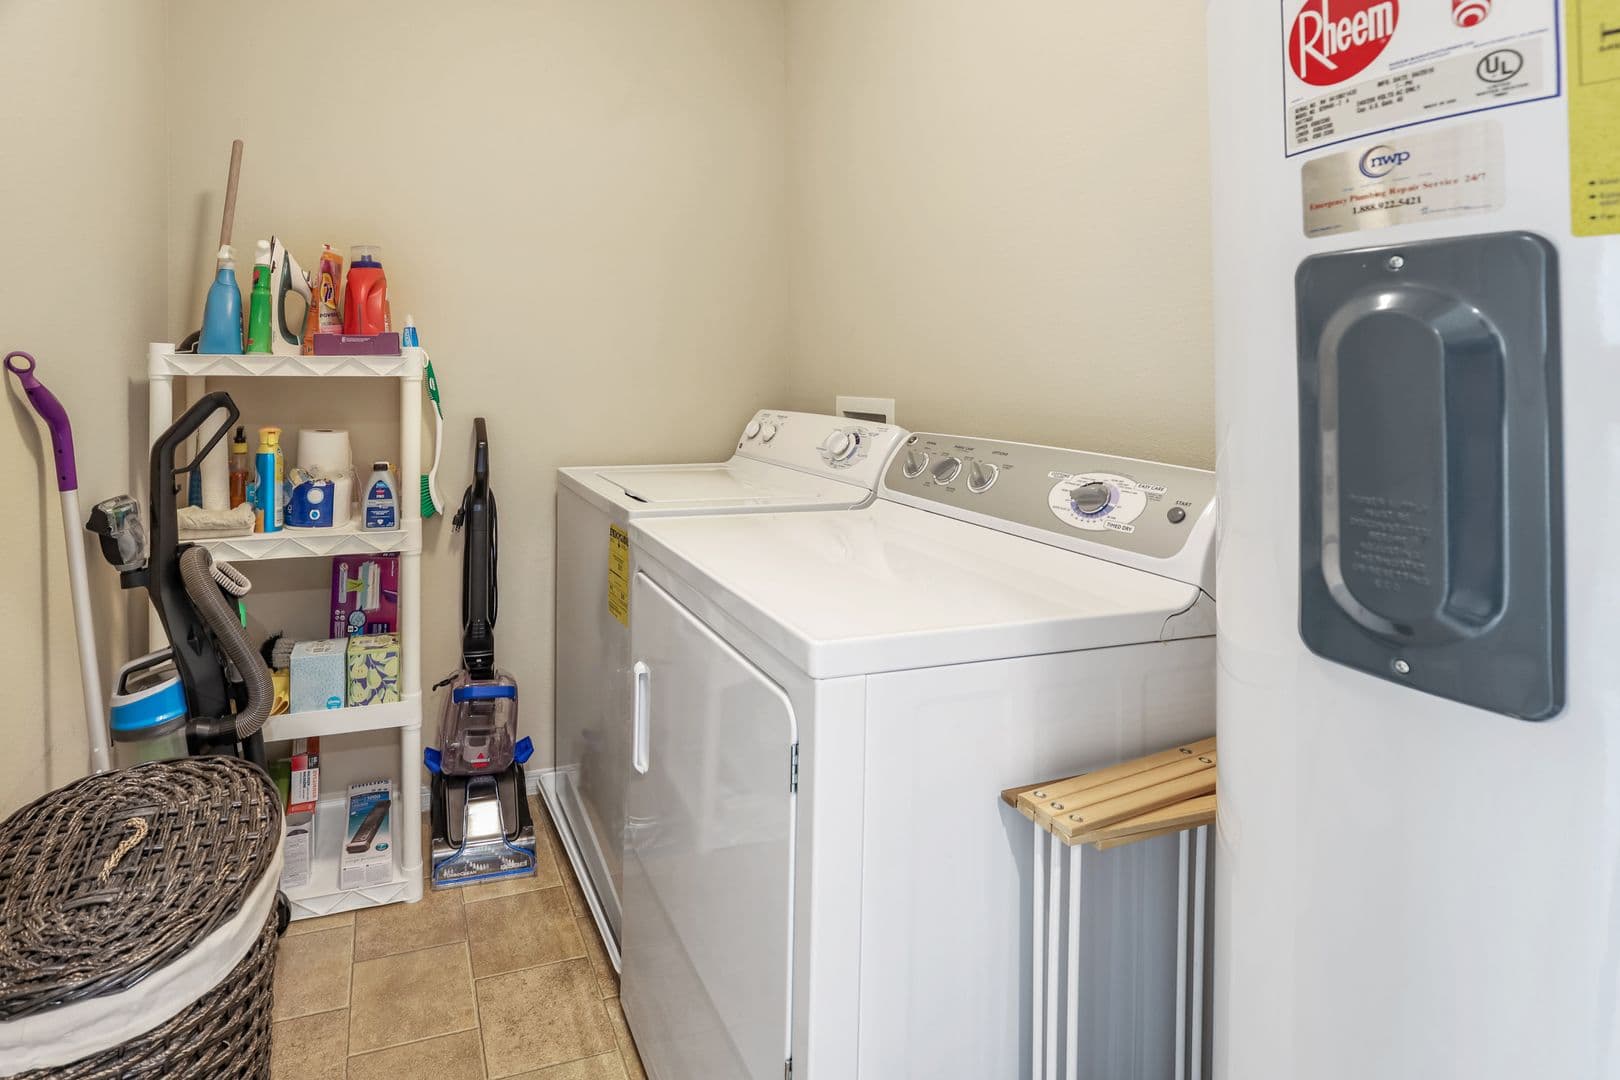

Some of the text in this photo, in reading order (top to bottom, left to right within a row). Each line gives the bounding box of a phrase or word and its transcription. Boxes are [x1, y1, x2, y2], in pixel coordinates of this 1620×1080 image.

[1298, 0, 1394, 79] Rheem
[1485, 55, 1514, 75] UL
[1371, 149, 1410, 168] nwp
[1309, 197, 1347, 212] Emergency
[1349, 189, 1386, 203] Plumbing
[1389, 183, 1419, 196] Repair
[1422, 177, 1458, 189] Service
[1464, 172, 1487, 183] 24/7
[1175, 499, 1192, 508] START
[1106, 521, 1133, 532] TIMED DRY
